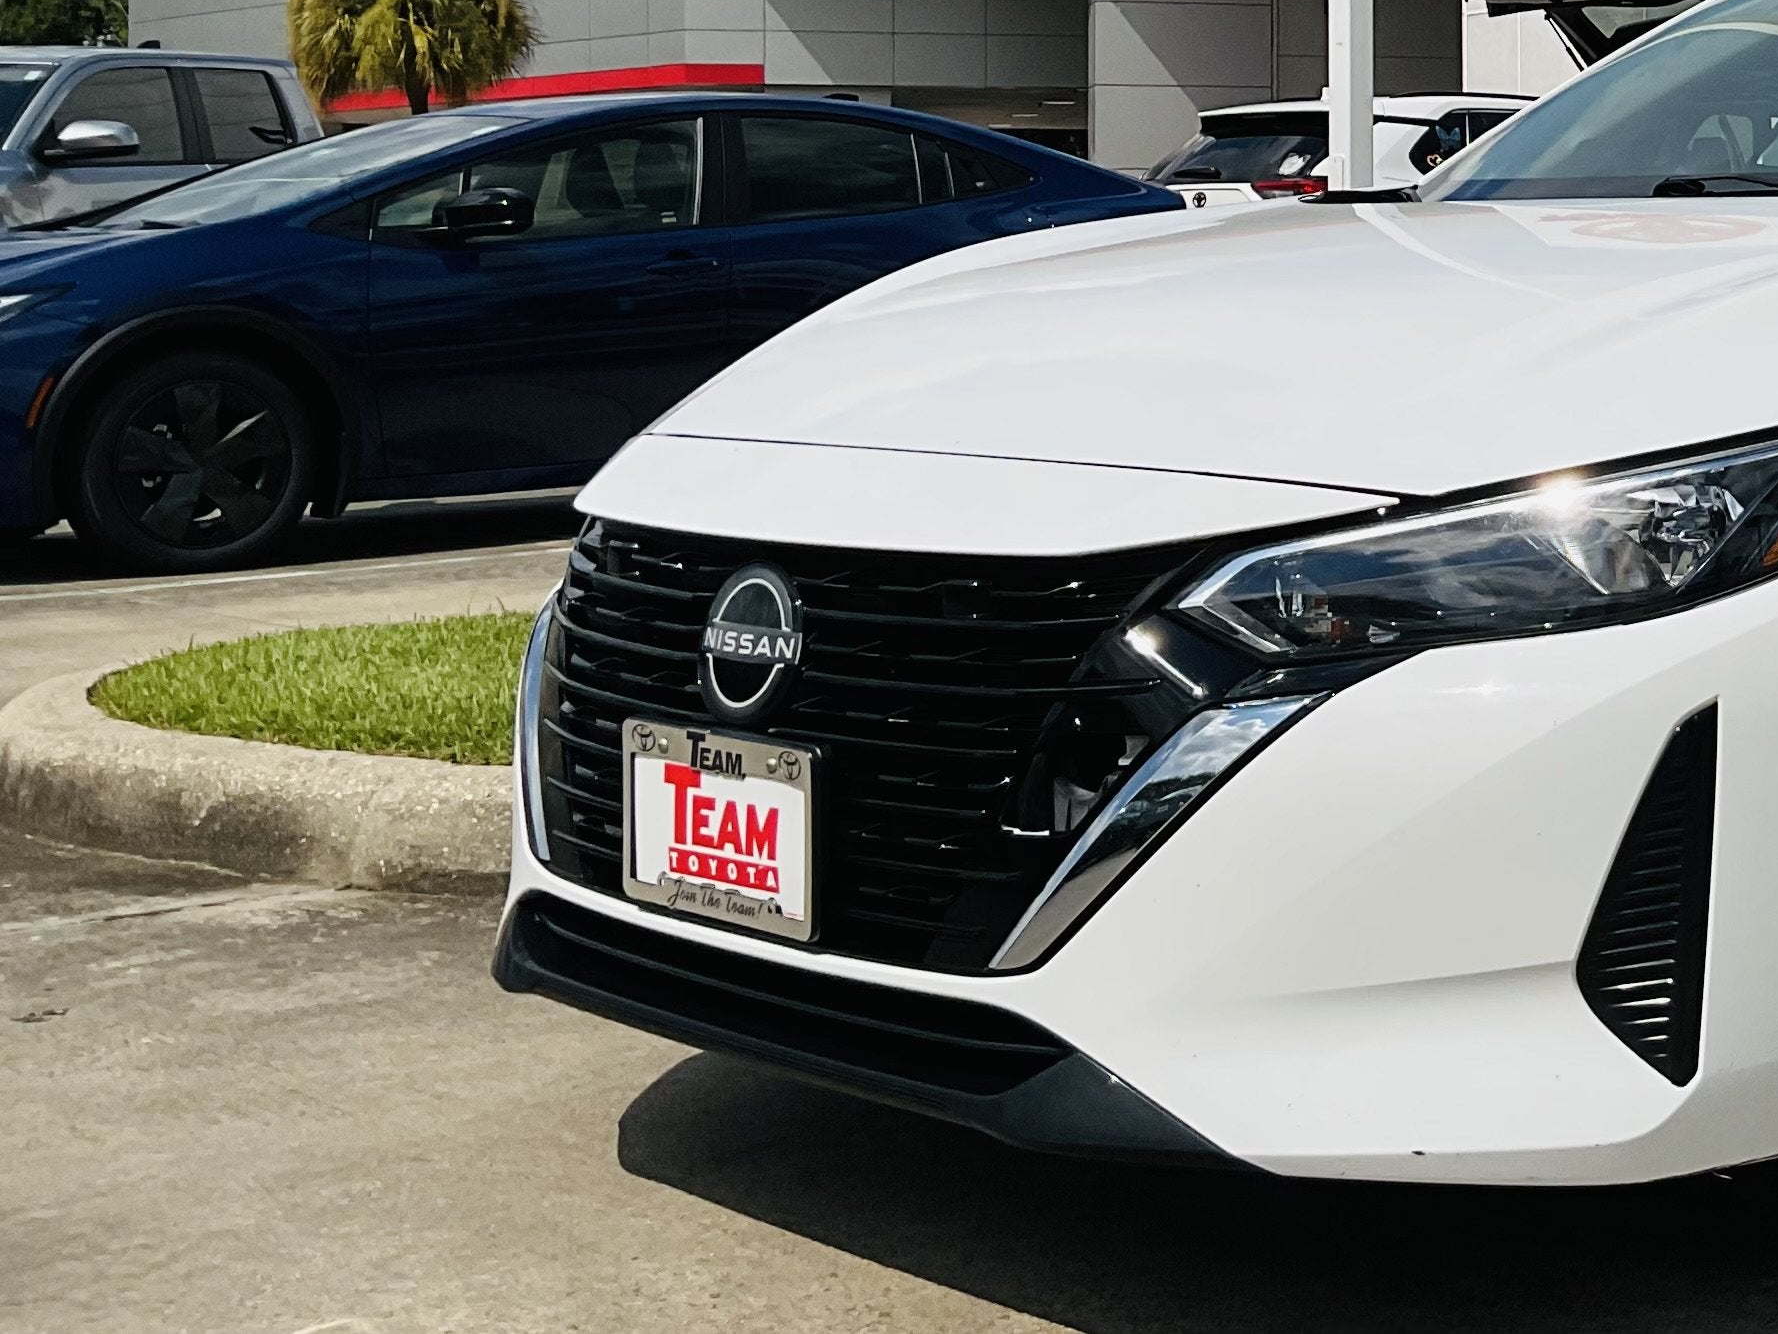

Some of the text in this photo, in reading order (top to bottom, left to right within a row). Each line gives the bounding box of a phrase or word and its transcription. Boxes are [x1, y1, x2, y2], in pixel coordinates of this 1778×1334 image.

[704, 626, 796, 659] NISSAN
[664, 762, 779, 861] TEAM
[669, 850, 777, 888] TOYOTA
